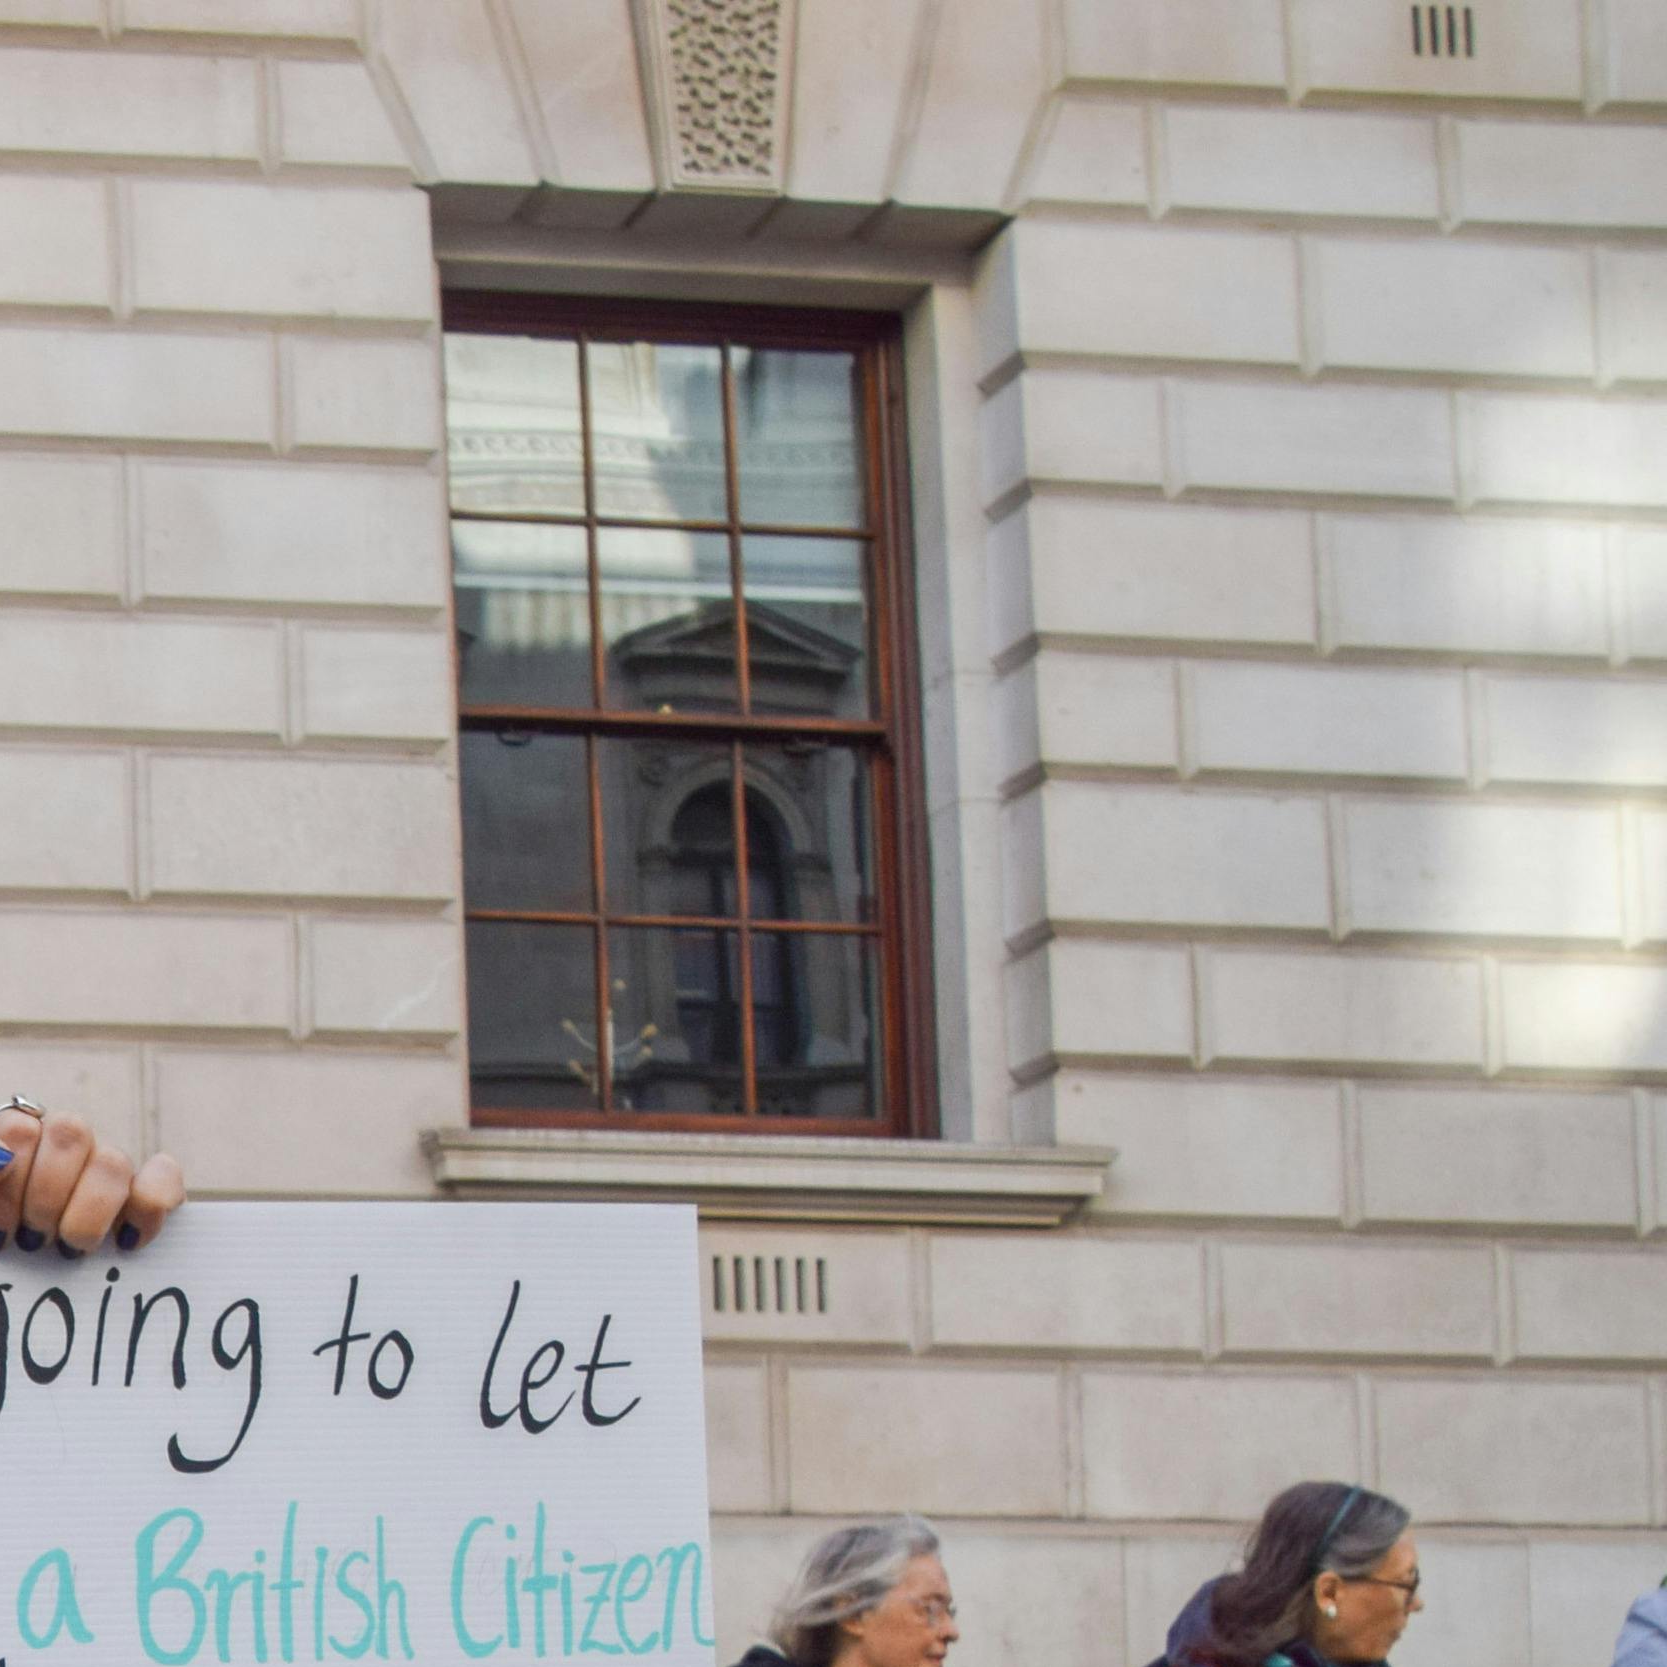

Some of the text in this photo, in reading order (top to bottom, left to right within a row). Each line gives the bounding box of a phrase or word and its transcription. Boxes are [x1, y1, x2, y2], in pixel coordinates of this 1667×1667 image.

[313, 1274, 415, 1400] to
[479, 1279, 641, 1435] let
[17, 1548, 94, 1650] a
[135, 1502, 415, 1666] British
[451, 1502, 714, 1659] Citizen
